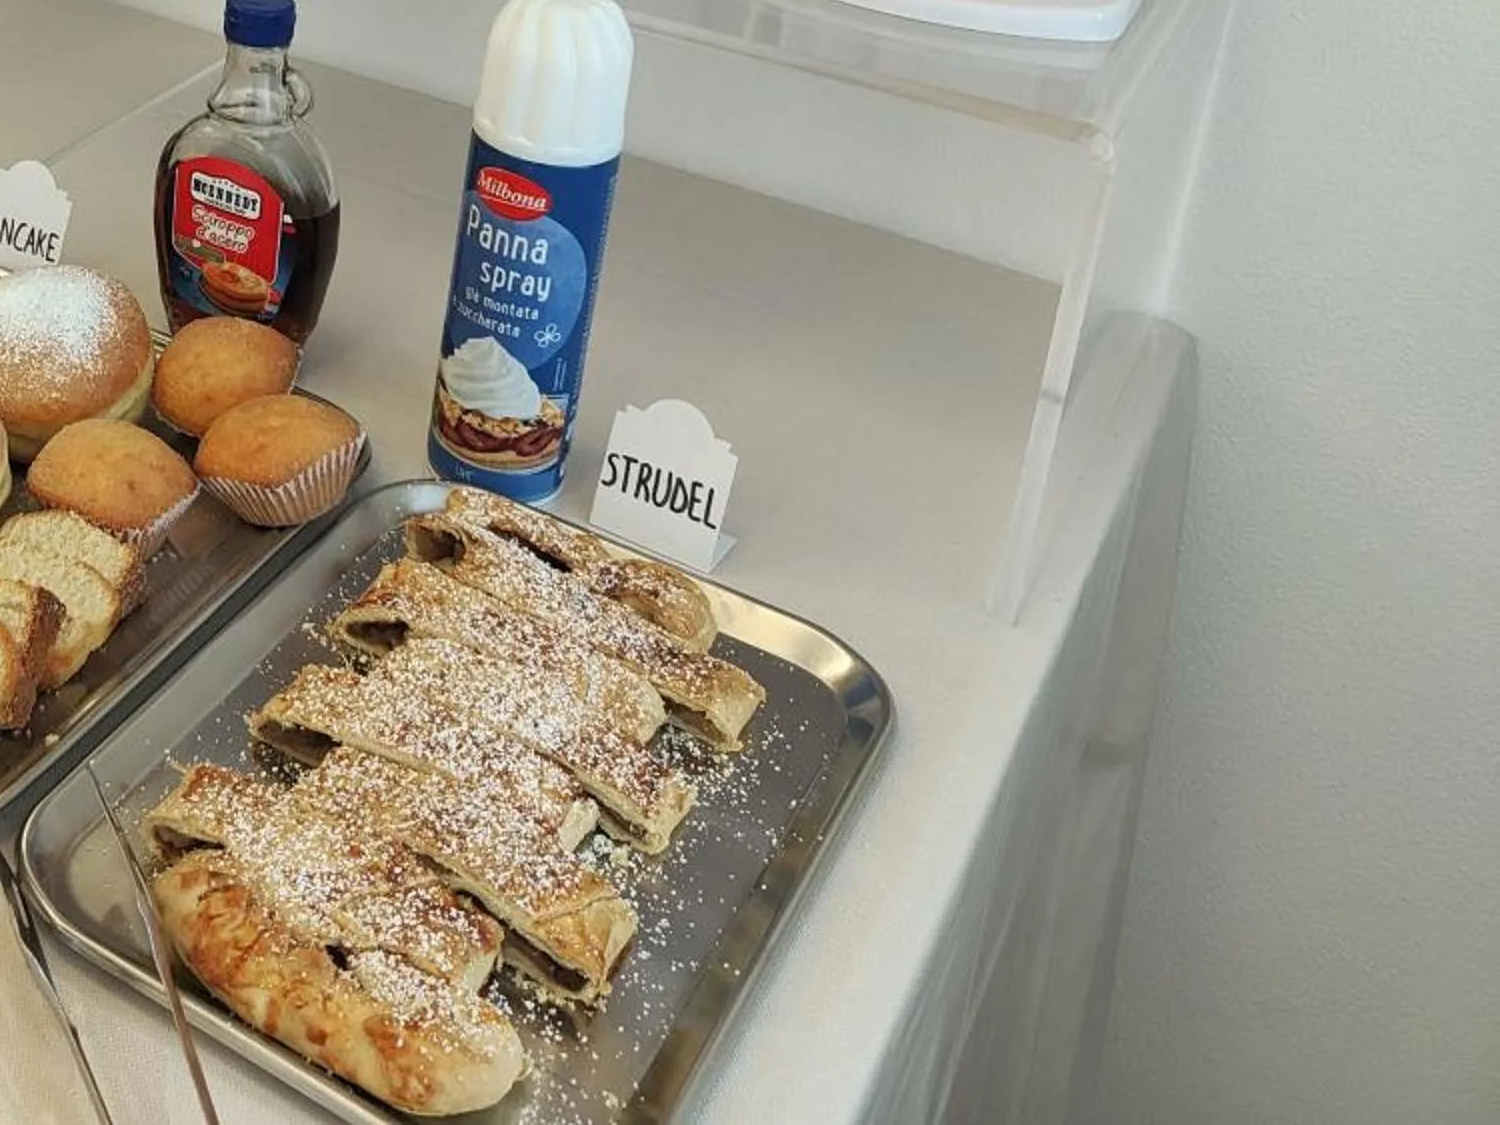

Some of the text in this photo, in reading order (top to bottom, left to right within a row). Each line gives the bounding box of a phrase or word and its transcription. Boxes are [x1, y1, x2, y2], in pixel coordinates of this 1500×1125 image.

[477, 170, 548, 209] Milbona
[467, 204, 549, 266] Panna
[480, 262, 552, 302] spray
[601, 452, 717, 530] STRUDEL
